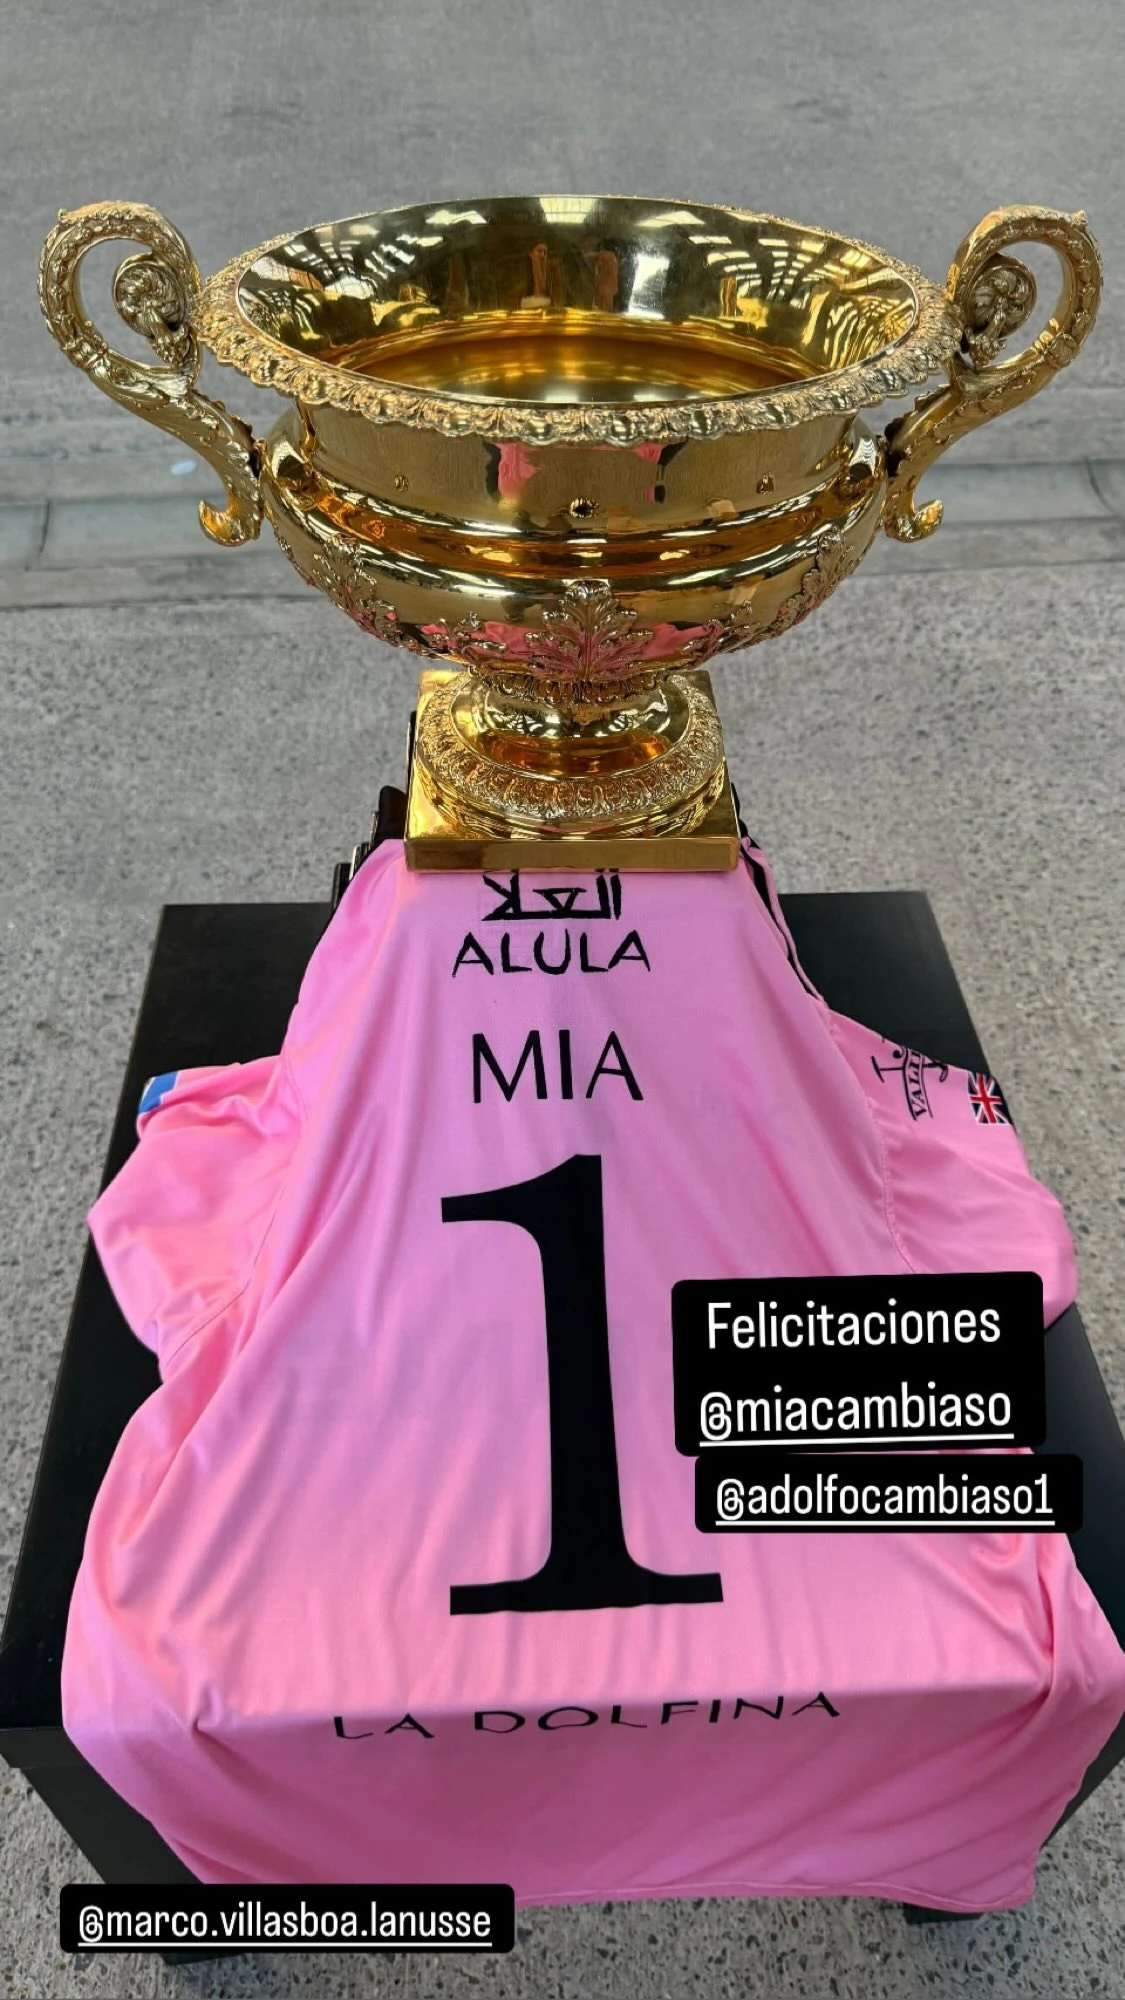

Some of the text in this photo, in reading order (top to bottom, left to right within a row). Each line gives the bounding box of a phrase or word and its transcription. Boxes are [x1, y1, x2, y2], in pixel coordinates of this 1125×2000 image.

[452, 928, 651, 978] ALULA
[472, 1029, 644, 1103] MIA
[441, 1154, 724, 1615] 1
[334, 1692, 841, 1739] LA DOLFINA
